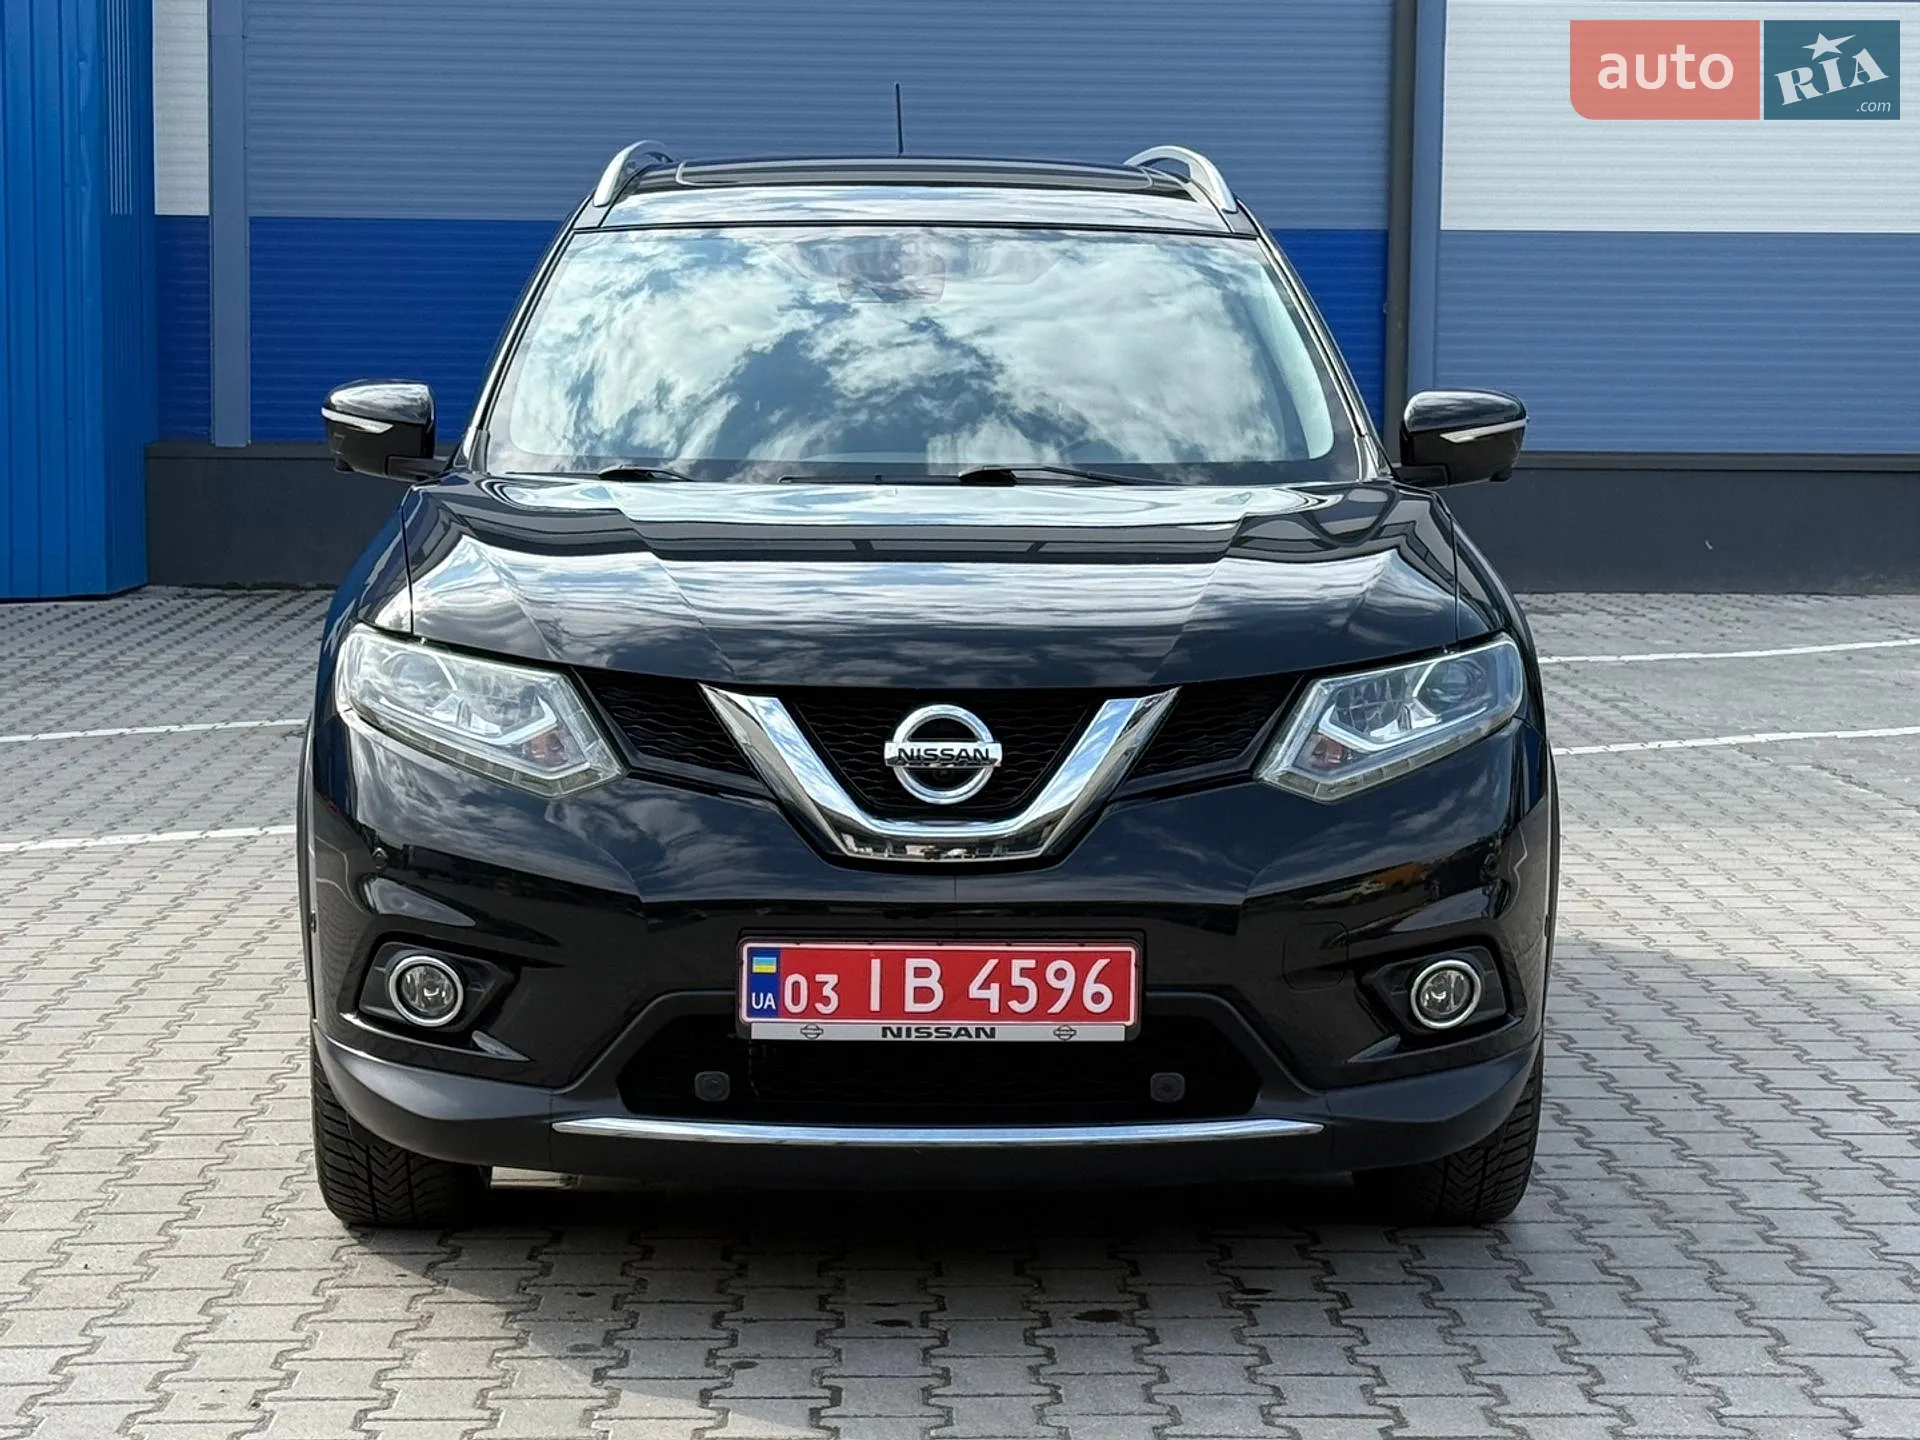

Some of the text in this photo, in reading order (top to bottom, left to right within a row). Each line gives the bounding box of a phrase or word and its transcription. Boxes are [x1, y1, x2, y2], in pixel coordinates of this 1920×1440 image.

[898, 748, 989, 761] NISSAN
[784, 973, 840, 1015] 03
[968, 958, 1115, 1014] 4596
[752, 992, 776, 1010] UA
[881, 1025, 997, 1040] NISSAN
